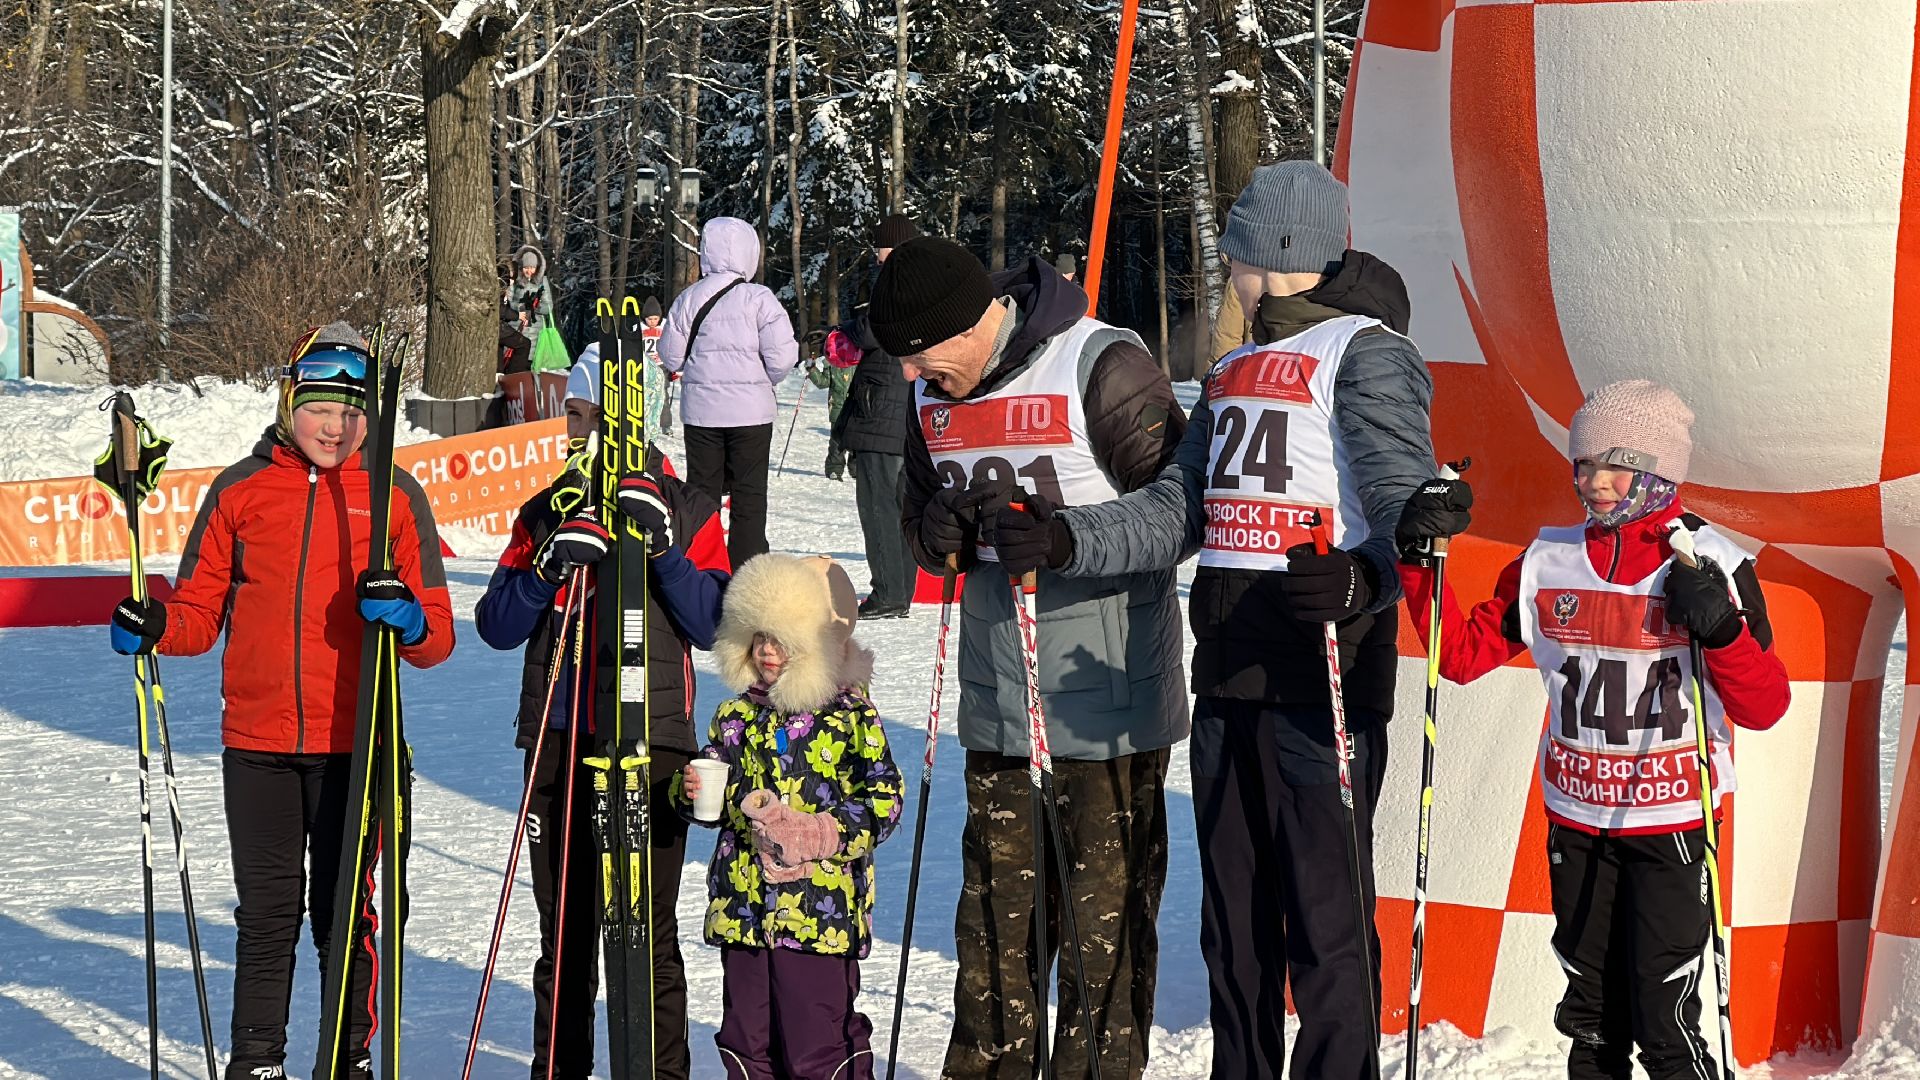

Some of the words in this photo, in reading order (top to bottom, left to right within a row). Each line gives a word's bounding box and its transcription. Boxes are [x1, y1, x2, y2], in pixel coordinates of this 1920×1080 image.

[1005, 397, 1051, 430] ГТО
[411, 433, 568, 487] CHOCOLATE
[1207, 405, 1293, 494] 24
[432, 486, 490, 506] ADIO
[1213, 503, 1262, 525] ВФСК
[1559, 655, 1688, 745] 144
[1597, 757, 1670, 780] ВФСК
[1675, 750, 1699, 775] ГТ
[1557, 778, 1689, 805] ОДИНЦОВО
